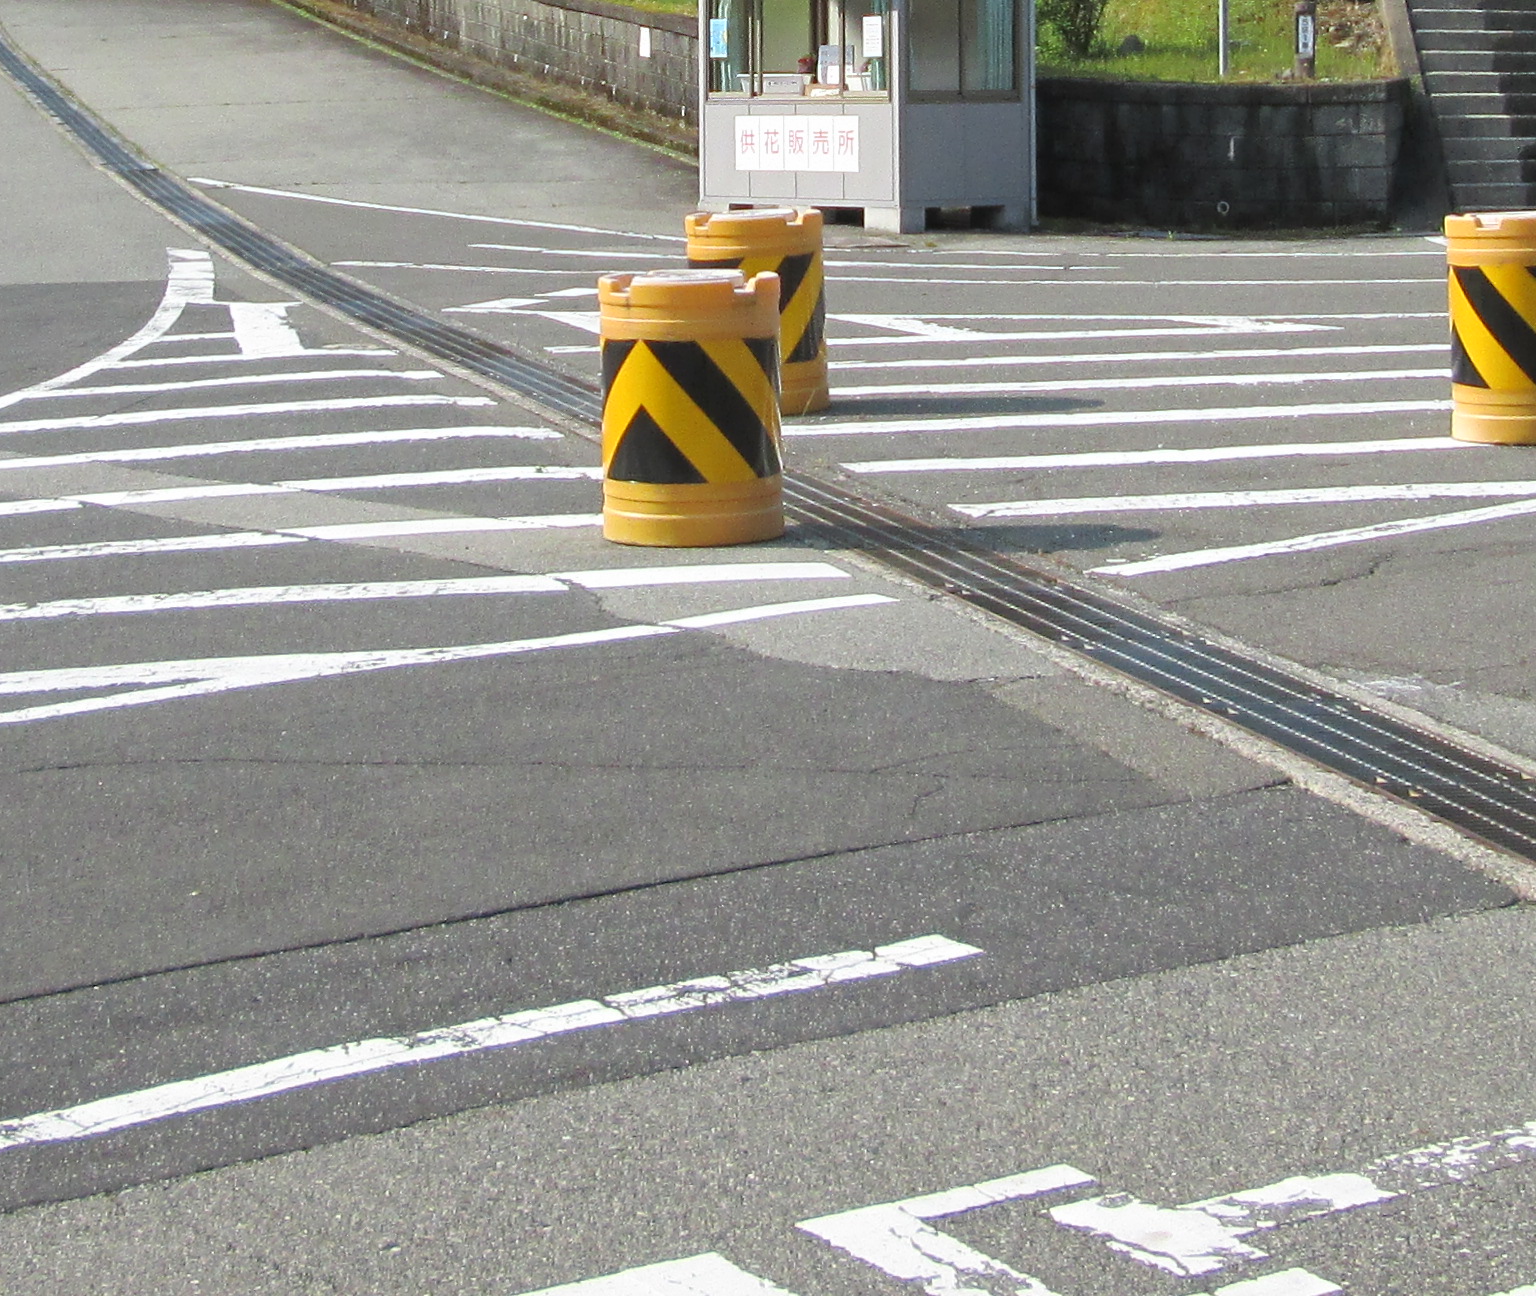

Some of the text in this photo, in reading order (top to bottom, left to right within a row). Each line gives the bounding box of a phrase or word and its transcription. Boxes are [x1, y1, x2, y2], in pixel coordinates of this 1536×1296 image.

[740, 128, 855, 156] 供花販売所
